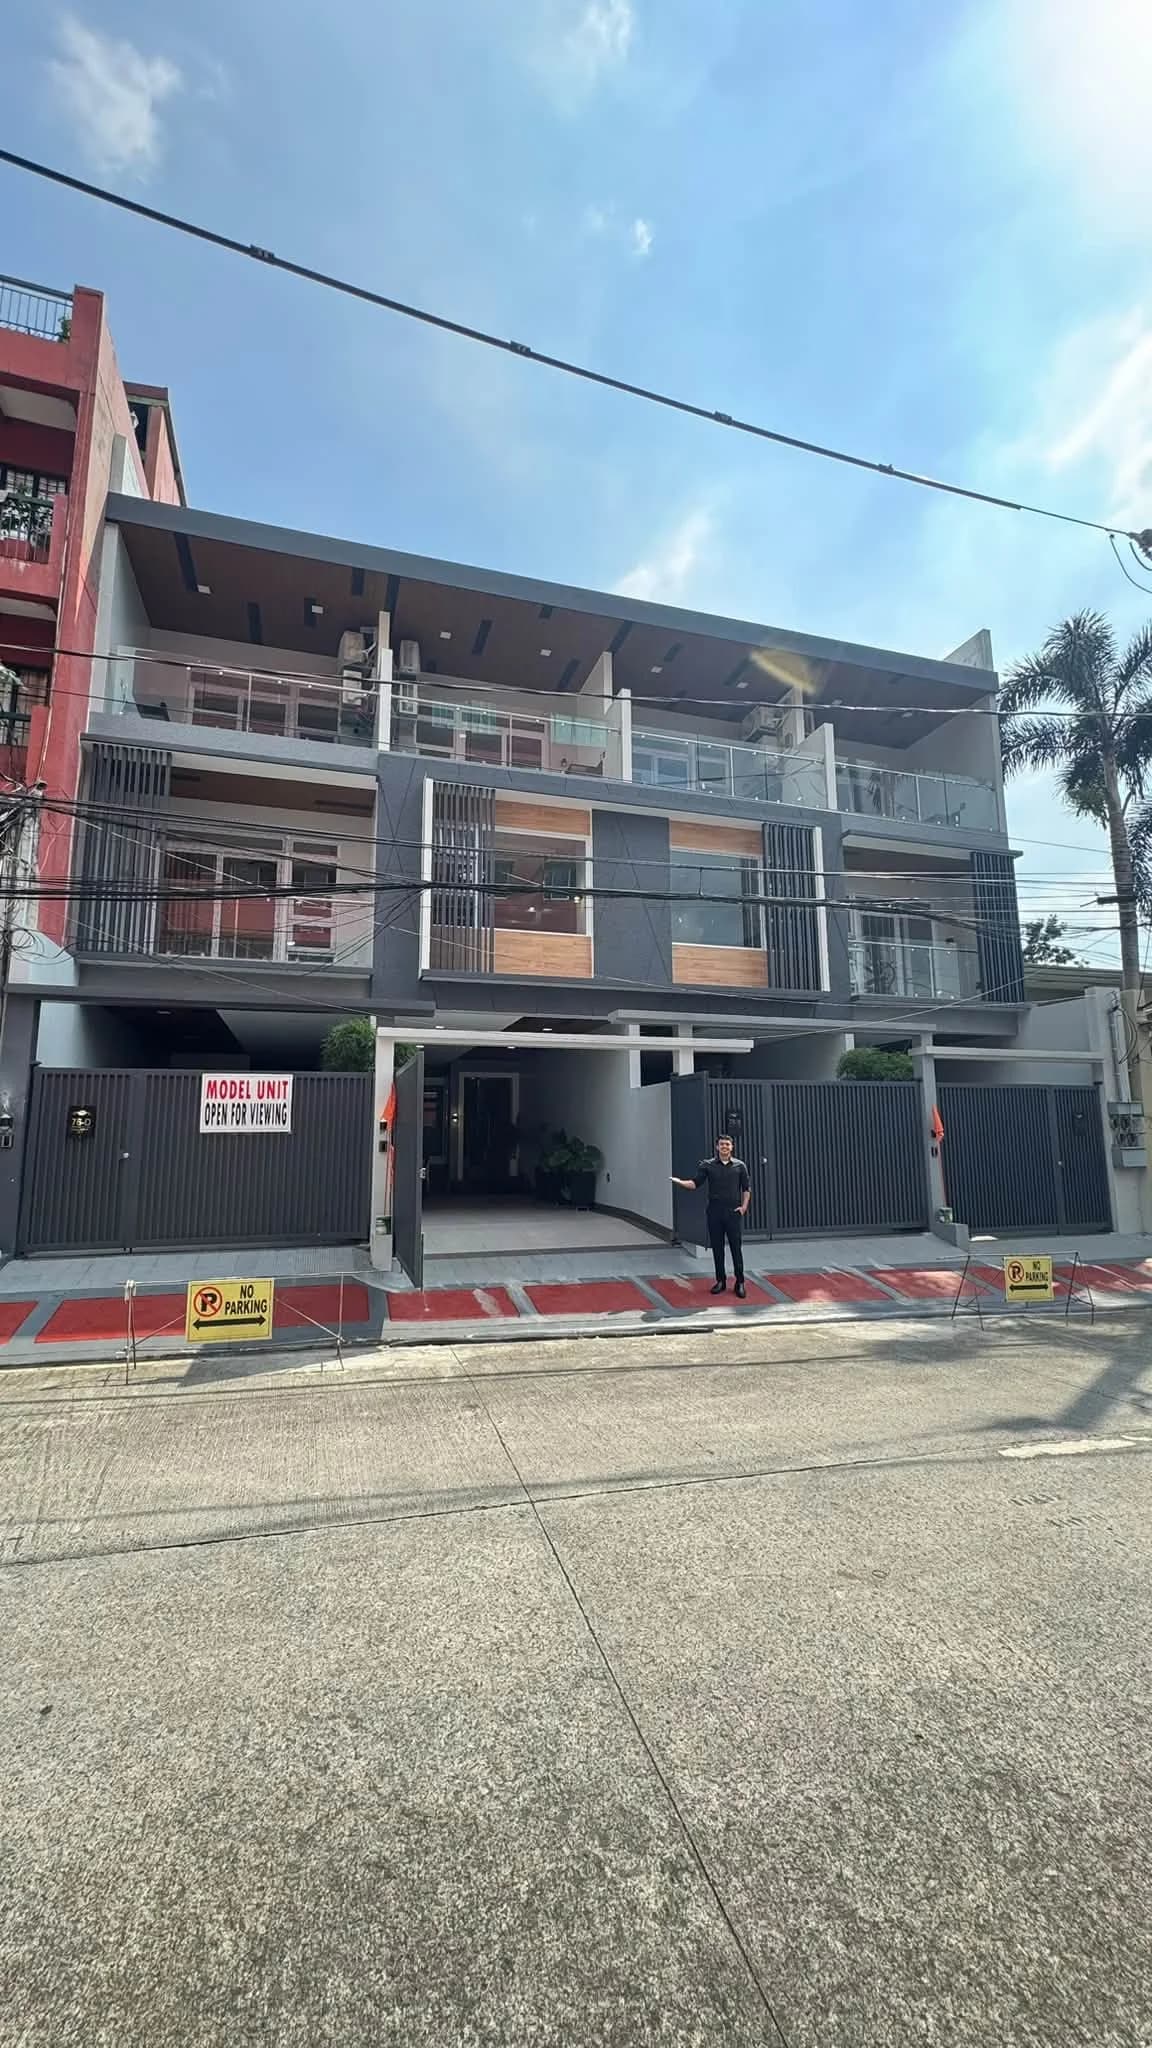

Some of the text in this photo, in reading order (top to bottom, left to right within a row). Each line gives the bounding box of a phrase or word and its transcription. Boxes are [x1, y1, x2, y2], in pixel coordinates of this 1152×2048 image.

[206, 1080, 288, 1099] MODEL UNIT
[205, 1103, 287, 1126] OPEN FOR VIEWING
[1033, 1261, 1041, 1270] NO
[1025, 1271, 1049, 1281] PARKING
[240, 1284, 254, 1299] NO
[224, 1299, 267, 1315] PARKING
